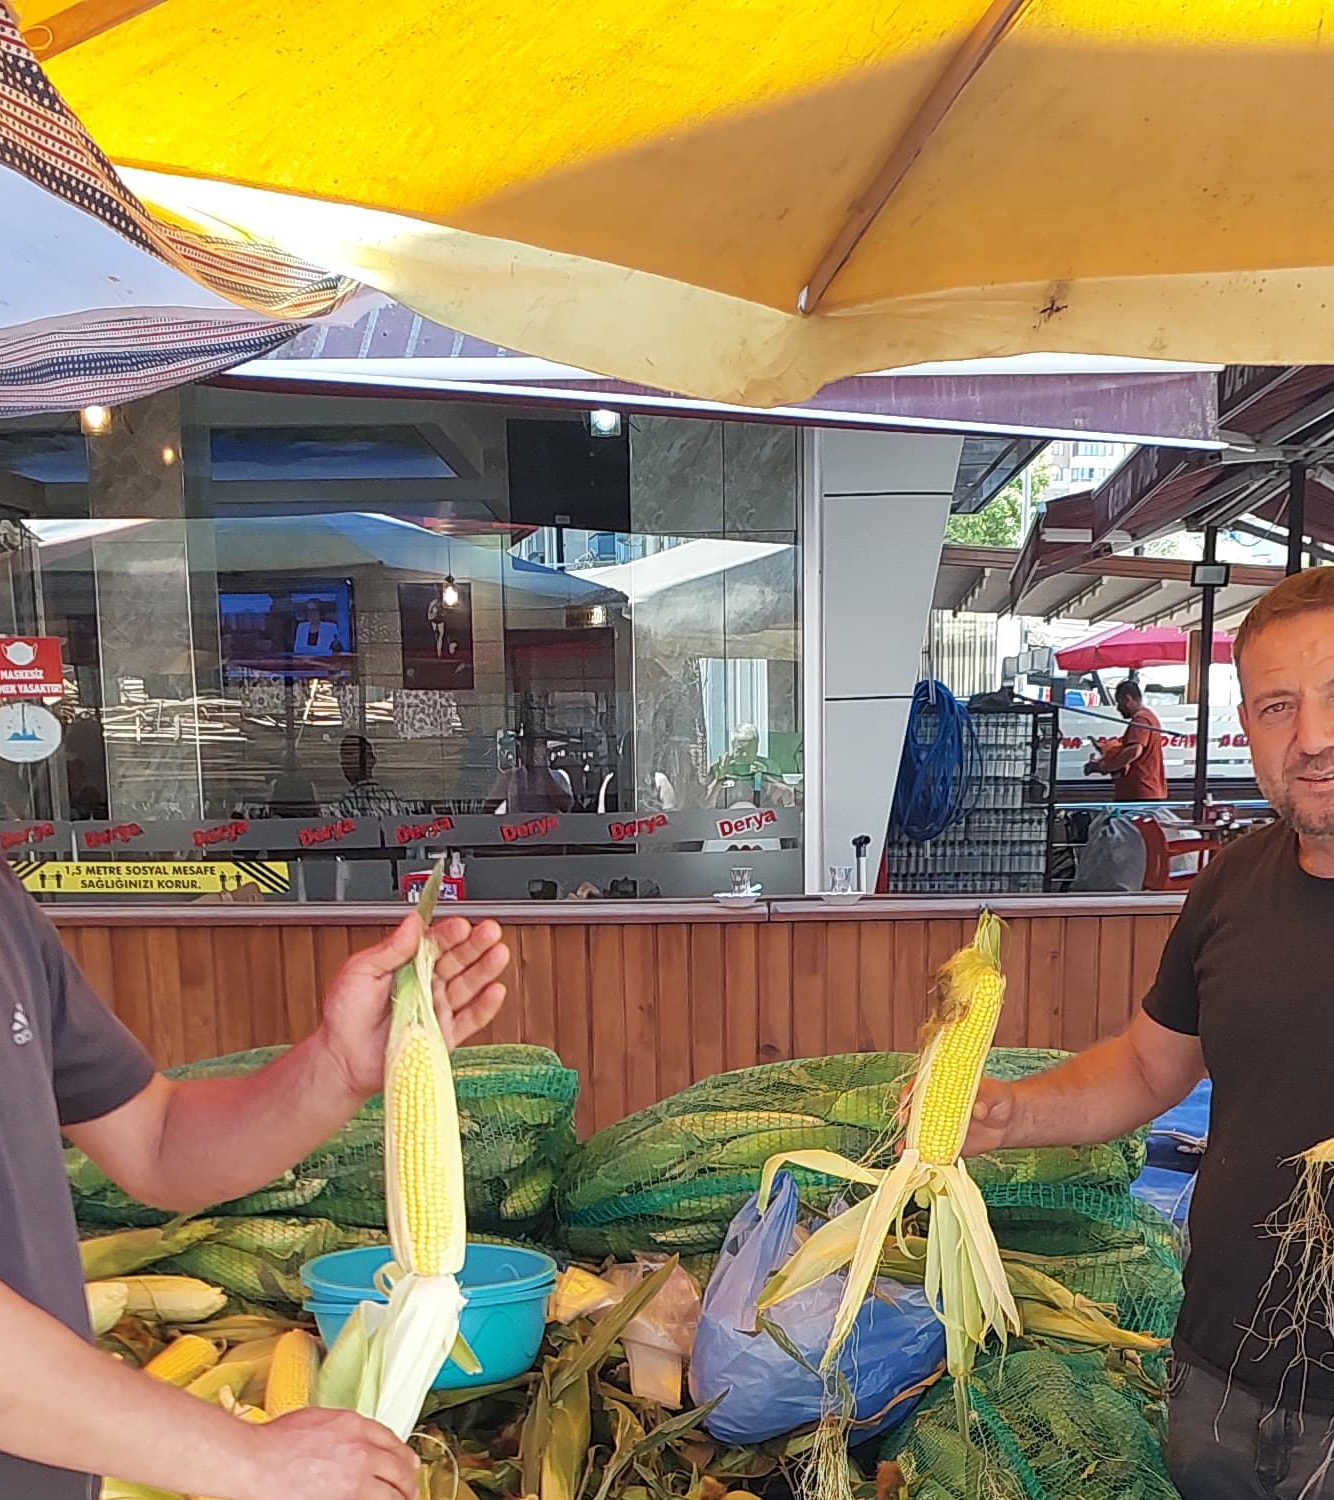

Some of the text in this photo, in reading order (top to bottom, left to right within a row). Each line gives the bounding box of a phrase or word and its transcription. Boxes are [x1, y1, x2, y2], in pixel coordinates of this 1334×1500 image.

[299, 818, 356, 846] Derya
[500, 815, 560, 842] Derya
[609, 812, 668, 841] Derya
[718, 808, 778, 837] Derya
[65, 866, 216, 877] 1,5 METRE SOSYAL MESAFE
